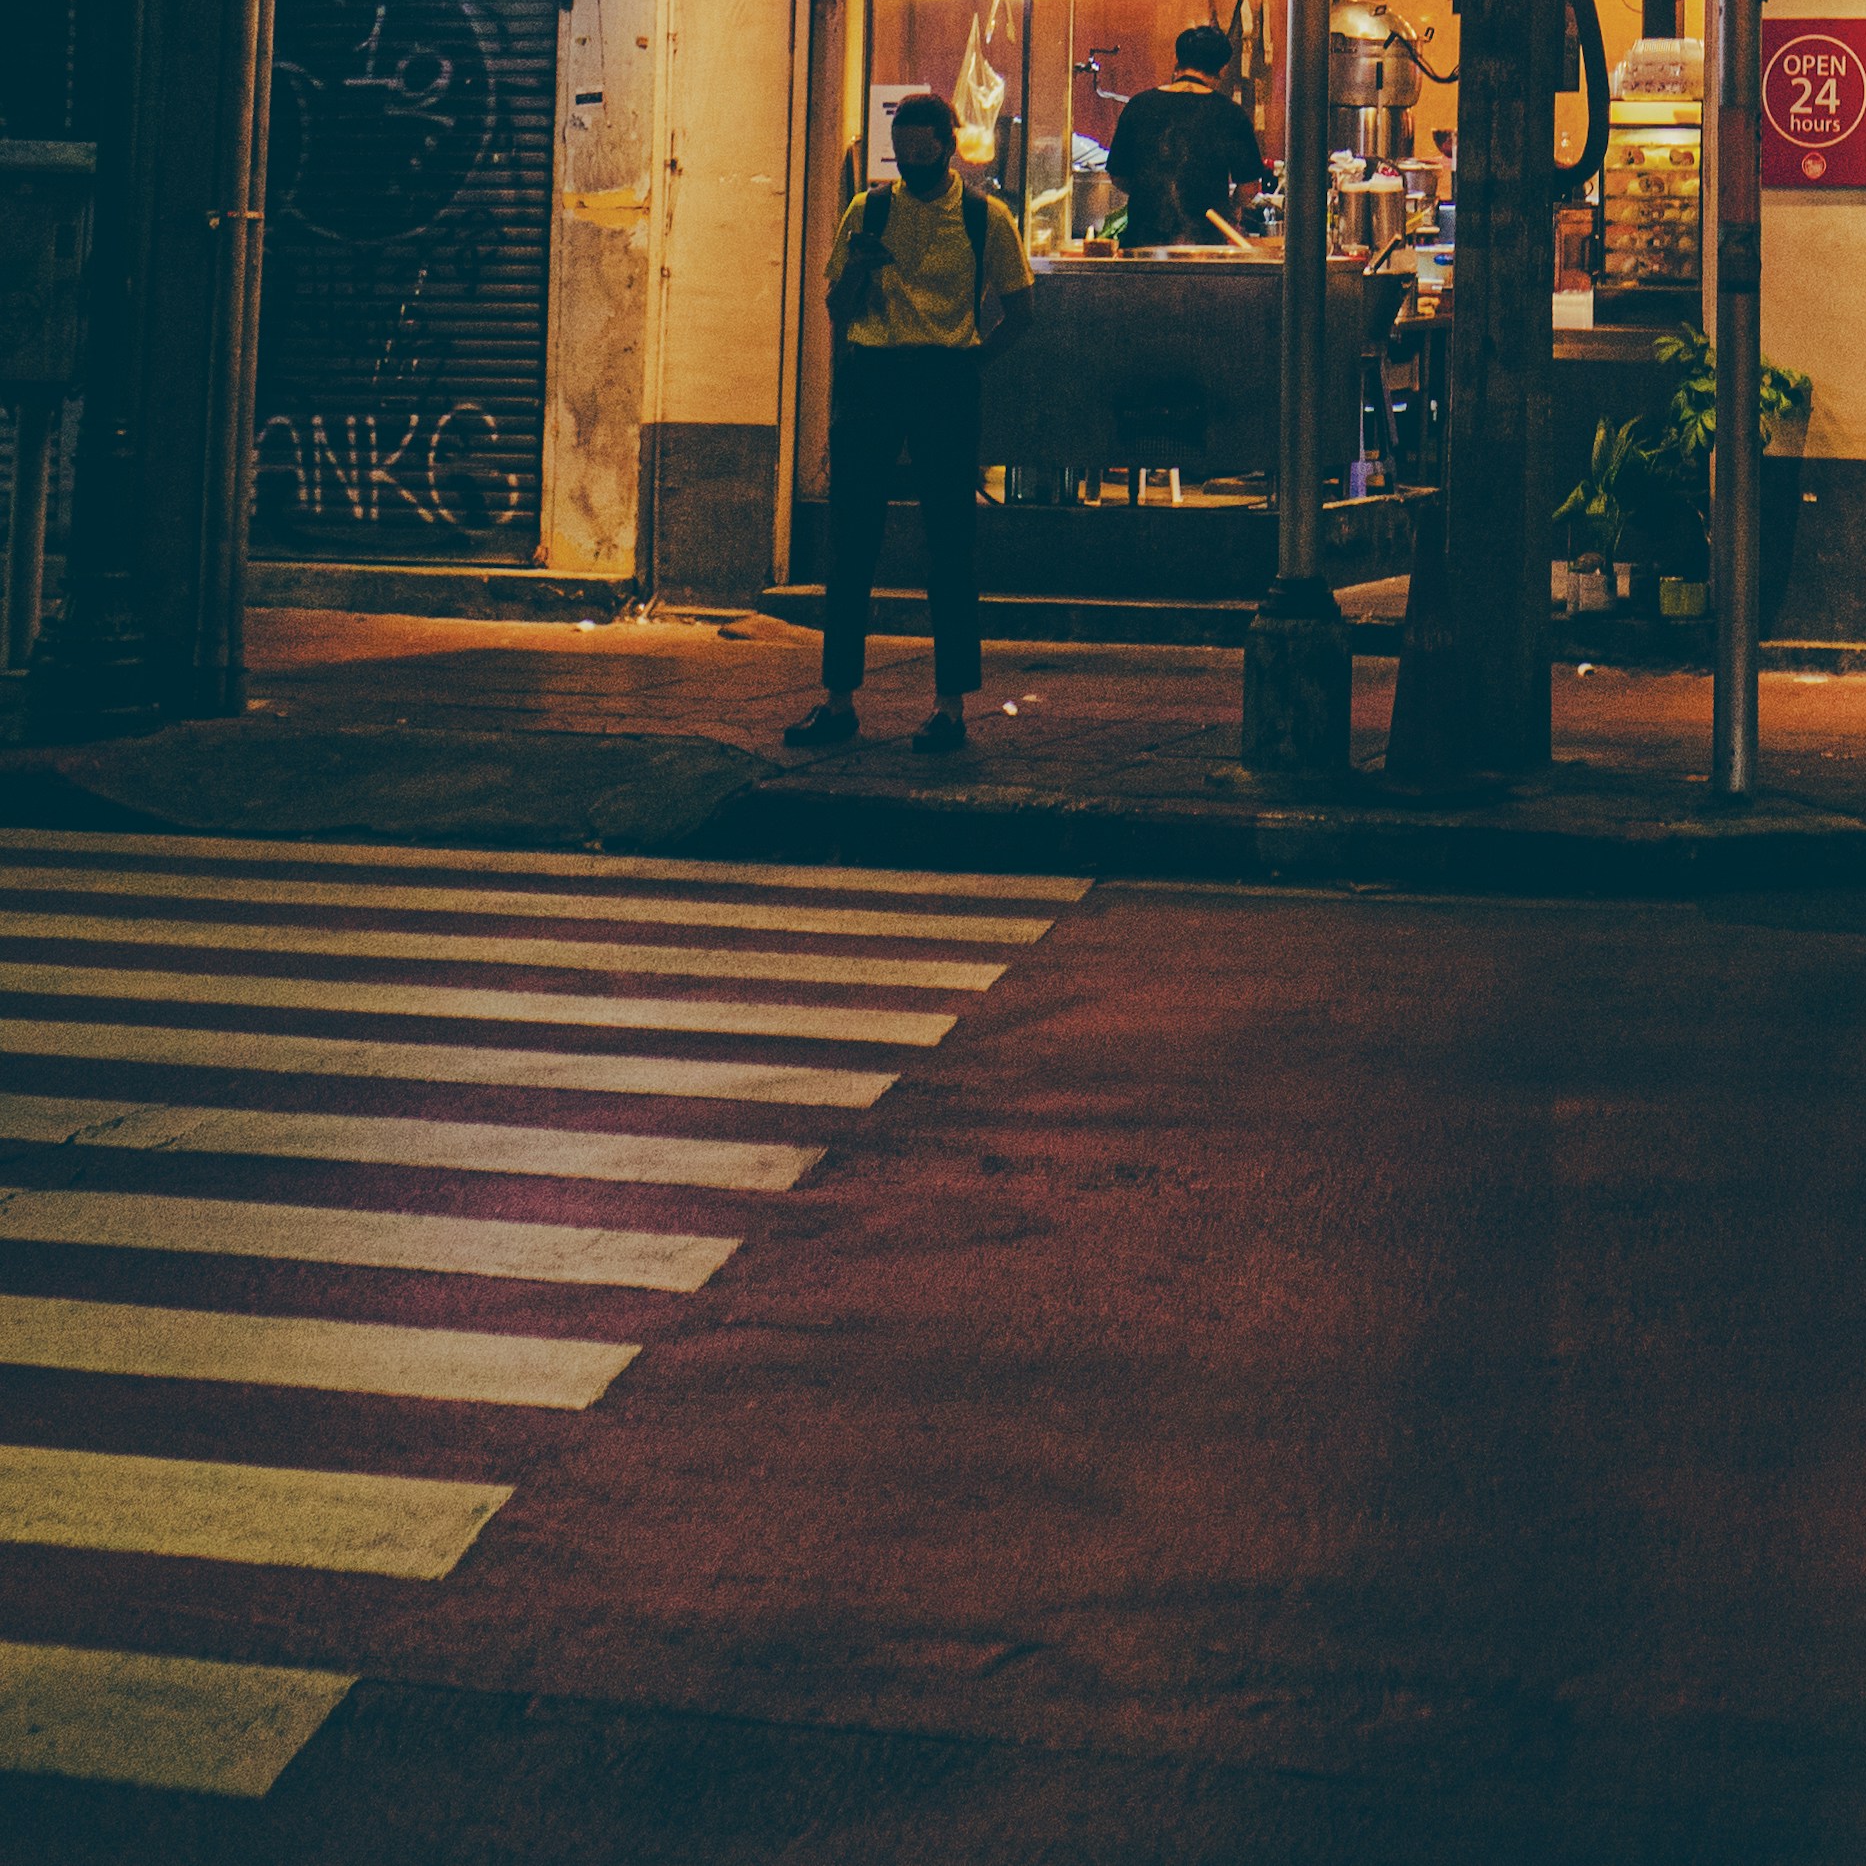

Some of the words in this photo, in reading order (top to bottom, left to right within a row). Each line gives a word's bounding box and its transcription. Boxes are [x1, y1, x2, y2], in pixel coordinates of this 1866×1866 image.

[1782, 54, 1847, 77] OPEN
[1789, 77, 1841, 115] 24
[1789, 113, 1841, 133] hours
